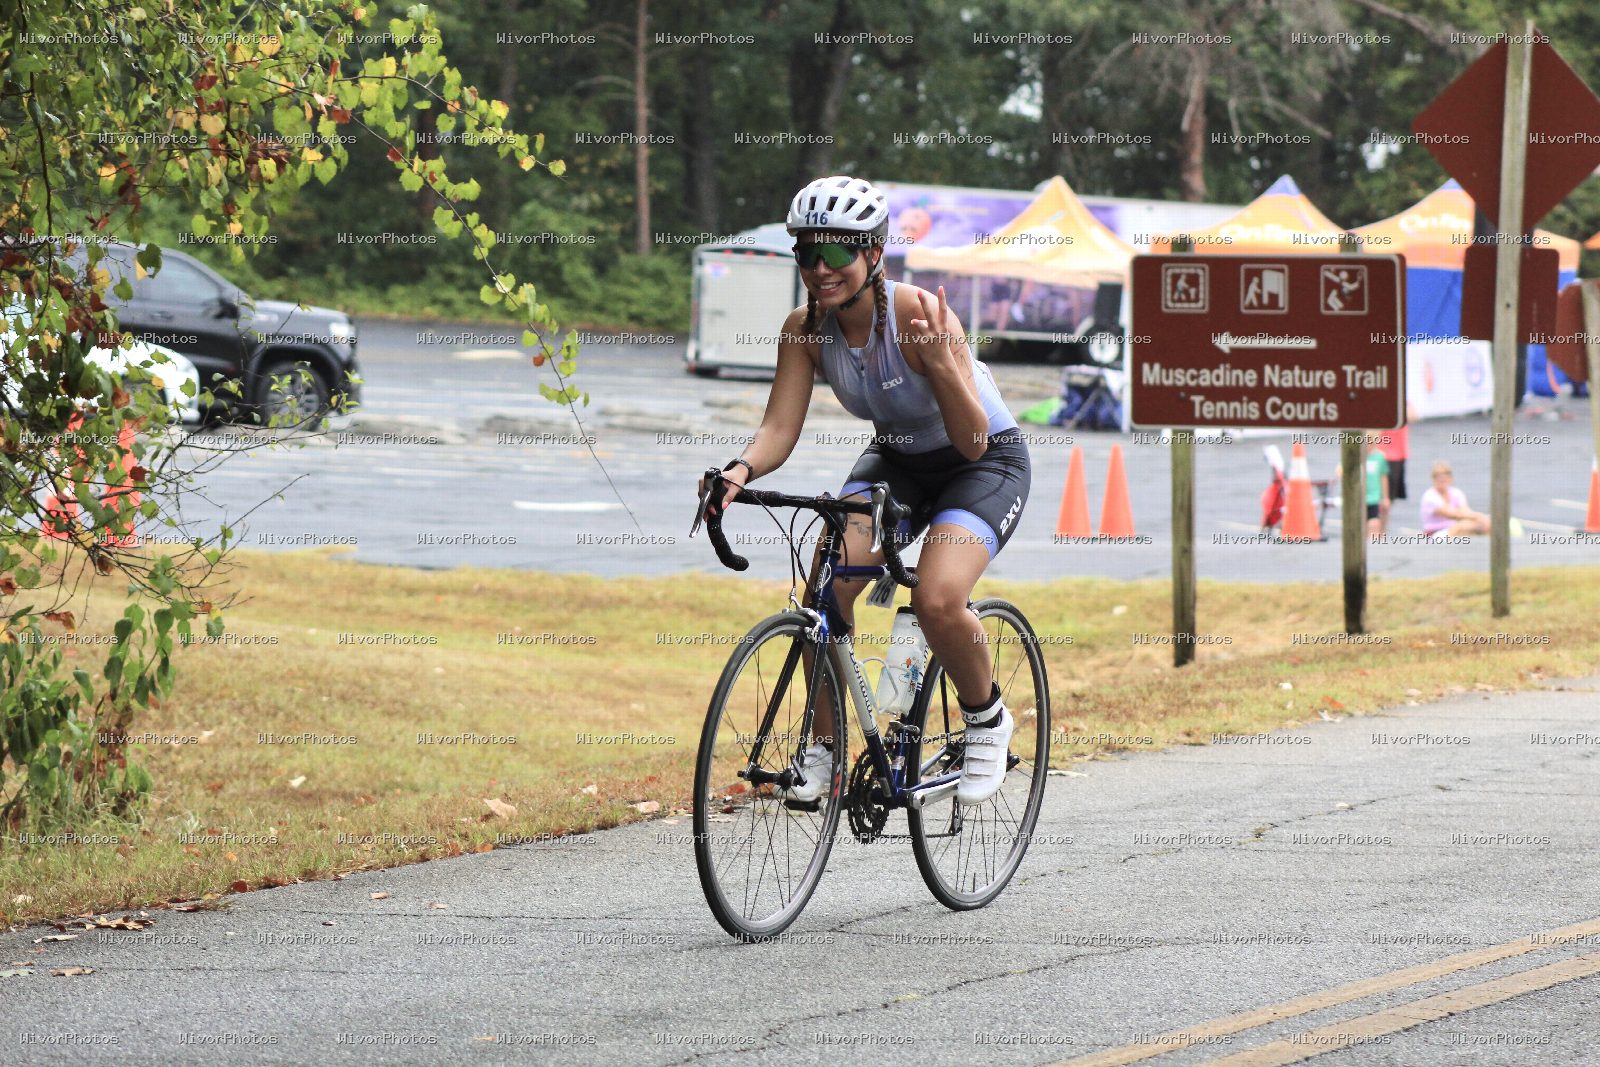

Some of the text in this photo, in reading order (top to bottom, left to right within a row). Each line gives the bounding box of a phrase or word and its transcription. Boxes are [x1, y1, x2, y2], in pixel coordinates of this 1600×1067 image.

[804, 211, 829, 226] 116
[882, 376, 904, 390] 2XU
[1142, 362, 1388, 389] Muscadine Nature Trail
[1190, 395, 1339, 421] Tennis Courts
[1000, 496, 1022, 536] 2XU
